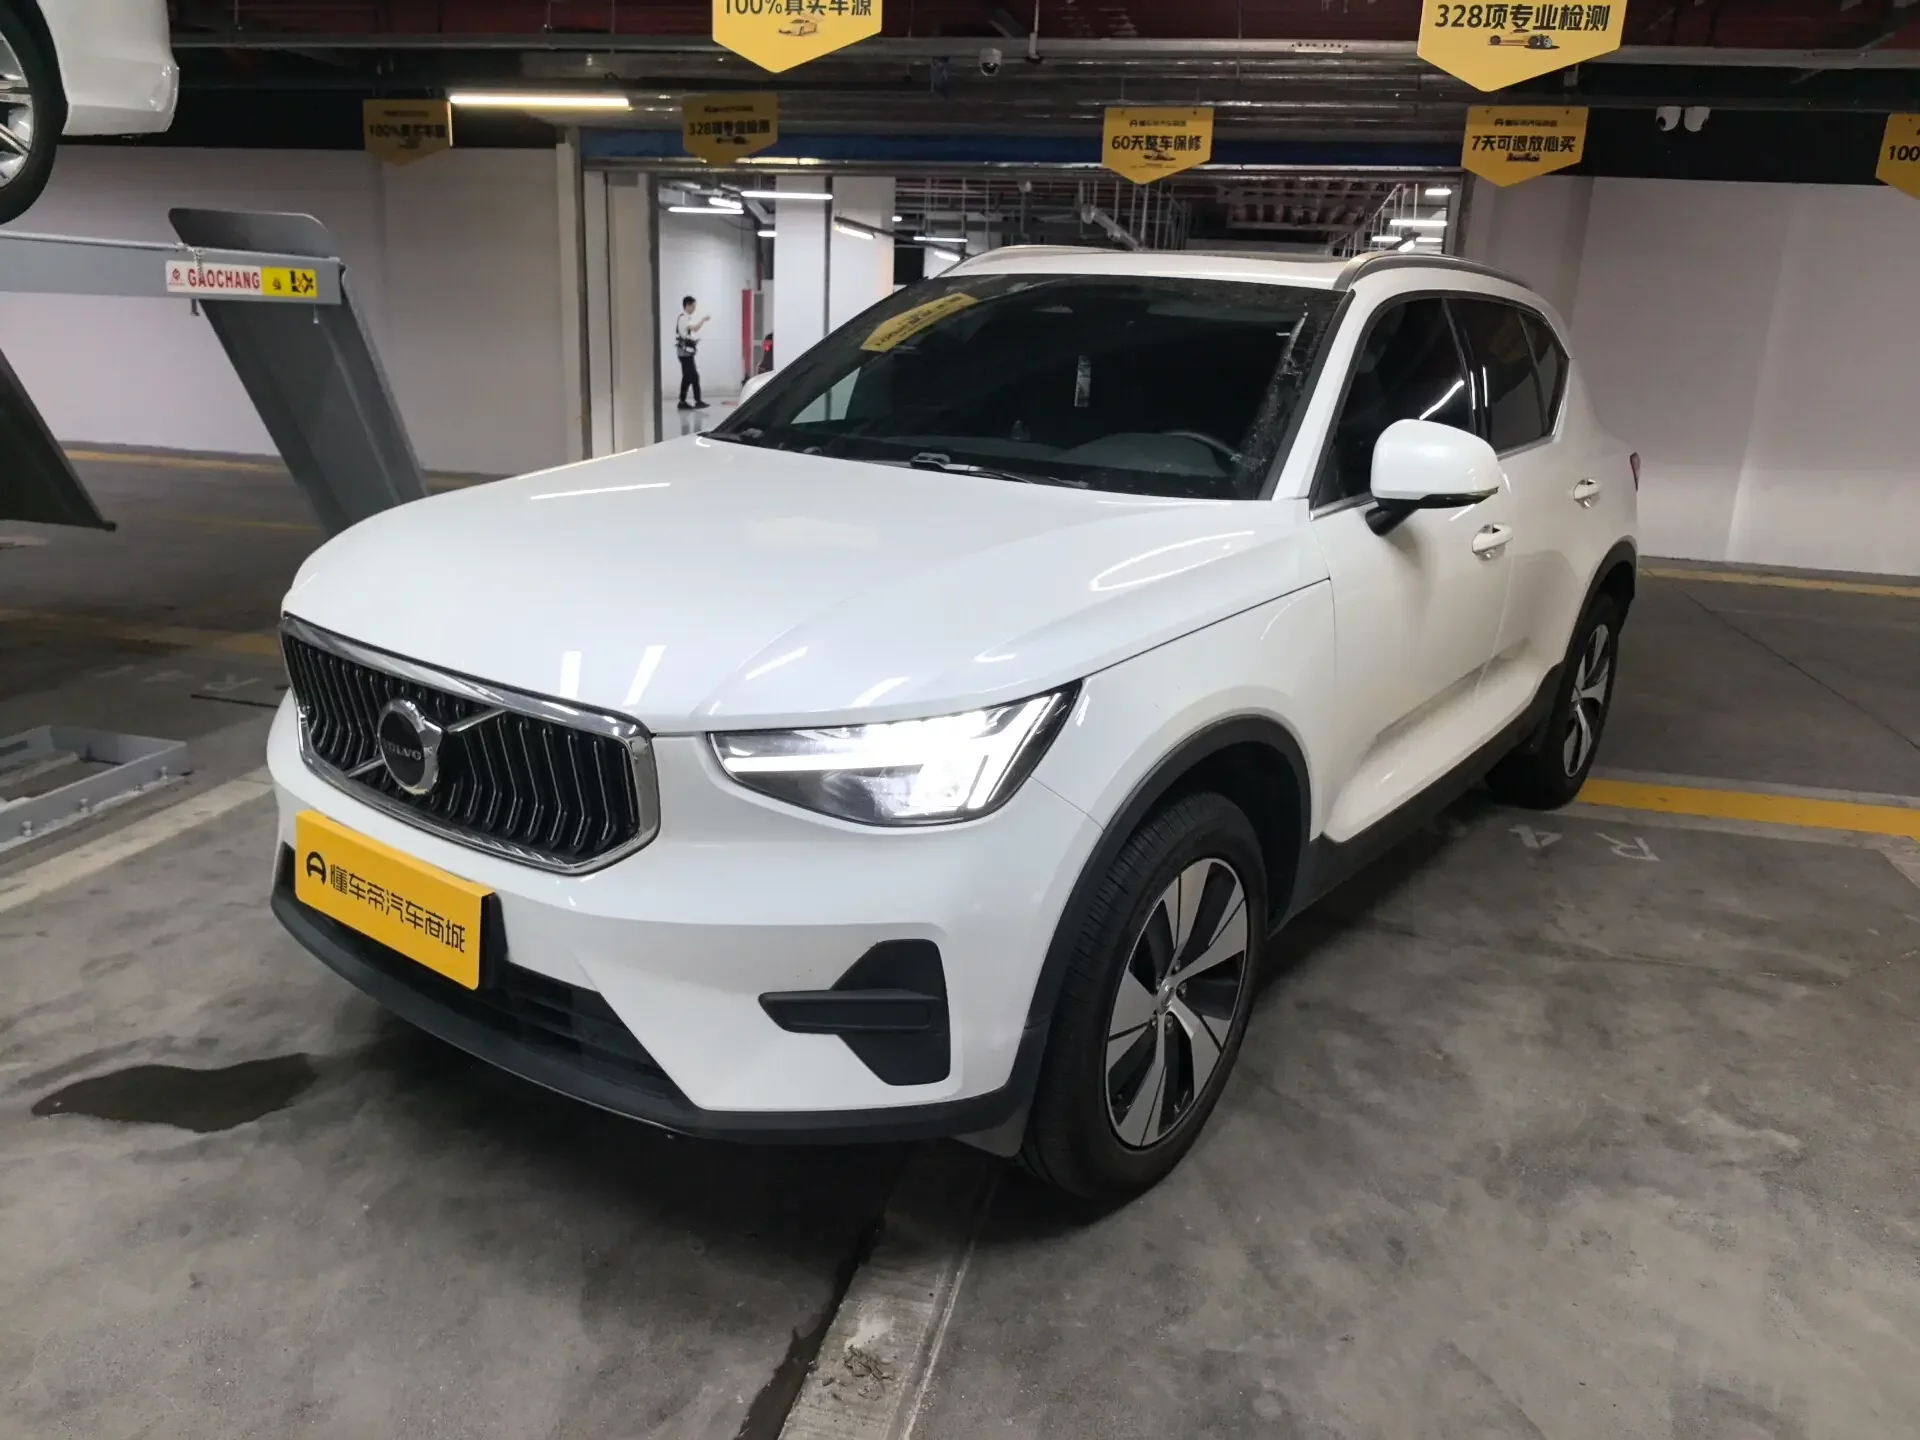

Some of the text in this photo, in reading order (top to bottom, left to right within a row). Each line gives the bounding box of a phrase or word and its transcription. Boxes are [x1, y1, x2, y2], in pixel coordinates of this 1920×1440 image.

[1434, 4, 1612, 31] 328项专业检测
[1111, 134, 1203, 152] 60天整车保修
[1471, 135, 1577, 152] 7天可退放心买
[187, 268, 261, 290] GAOCHANG
[382, 738, 422, 760] VOLVO
[330, 863, 466, 953] 懂车帝汽车商城
